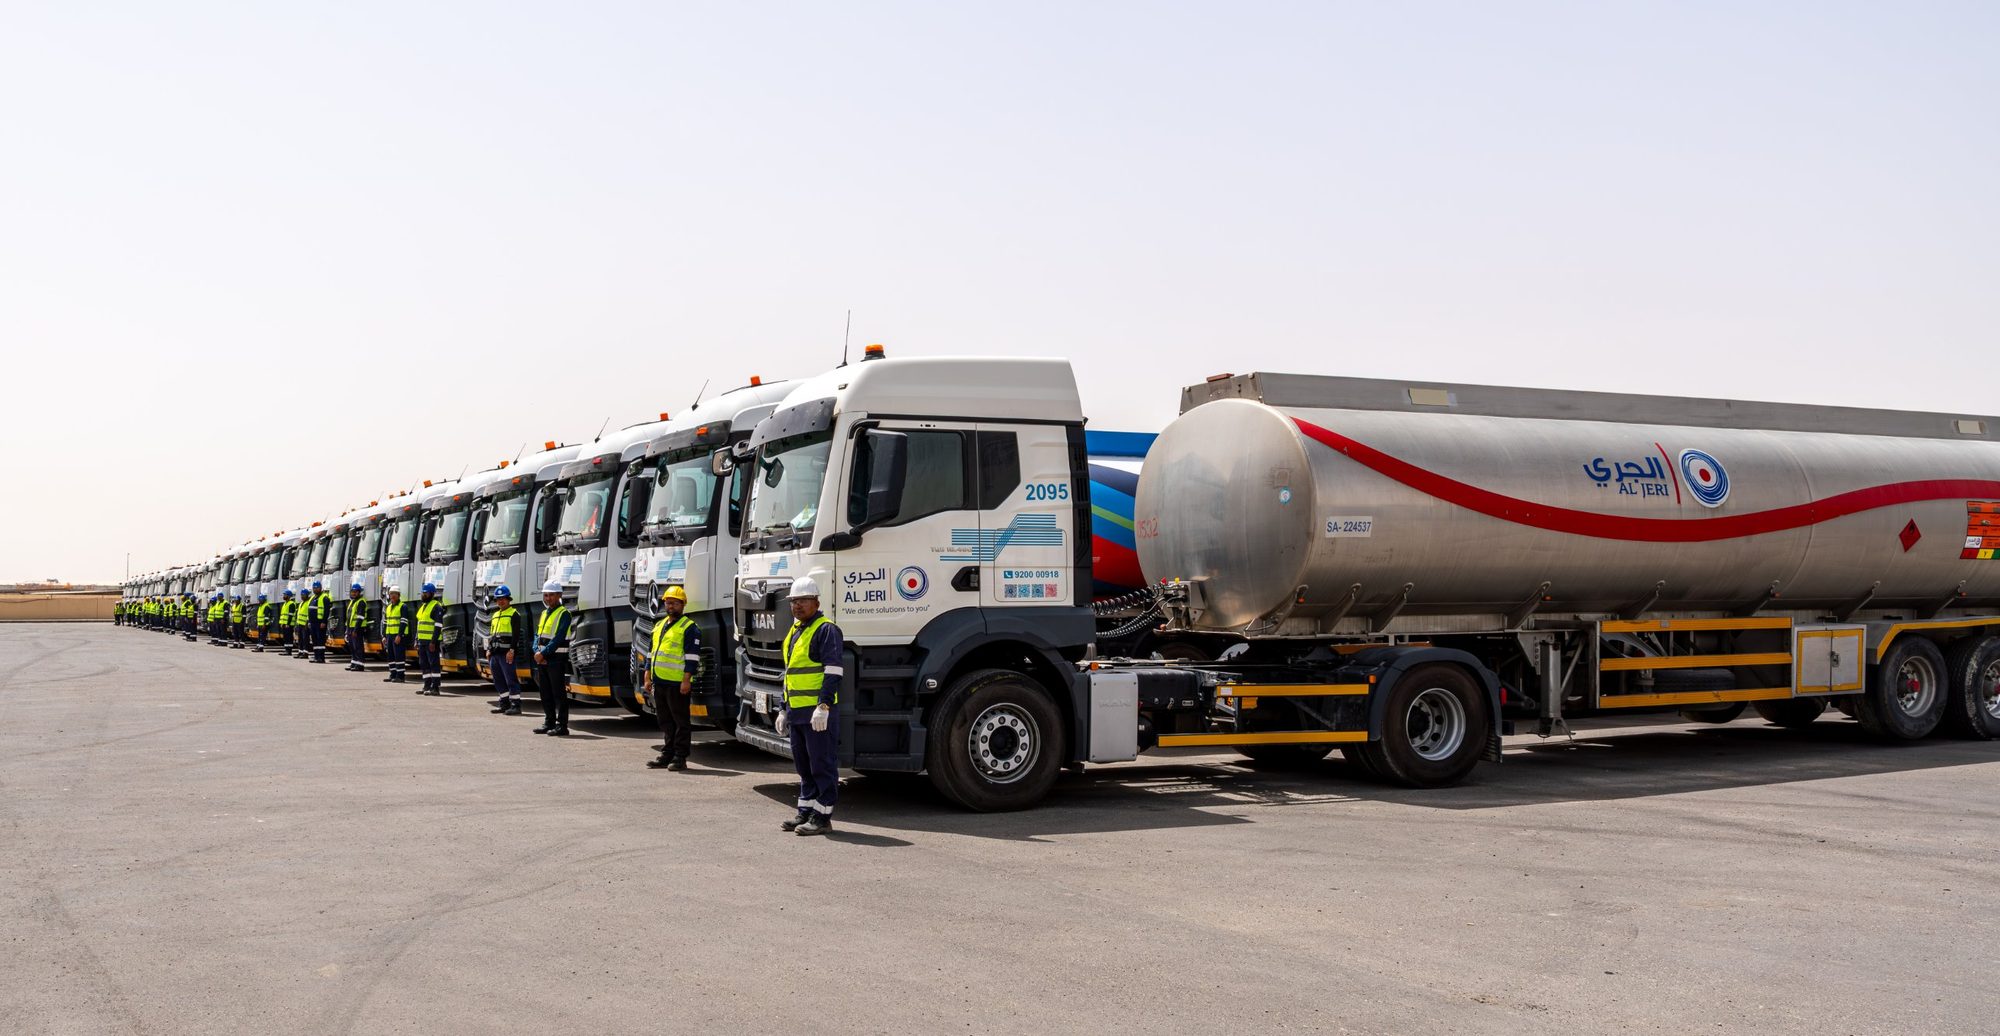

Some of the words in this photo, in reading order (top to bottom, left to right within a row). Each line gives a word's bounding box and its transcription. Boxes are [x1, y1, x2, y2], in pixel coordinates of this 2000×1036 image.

[1583, 456, 1666, 488] الجري
[1025, 483, 1069, 501] 2095
[1618, 482, 1637, 495] AL
[1642, 483, 1669, 498] JERI
[1343, 521, 1371, 532] 224537
[843, 567, 886, 589] الجري
[1014, 570, 1034, 579] 9200
[1035, 570, 1059, 578] 00918
[844, 591, 860, 603] AL
[863, 590, 886, 602] JERI
[875, 606, 906, 614] solutions
[915, 604, 930, 613] you"
